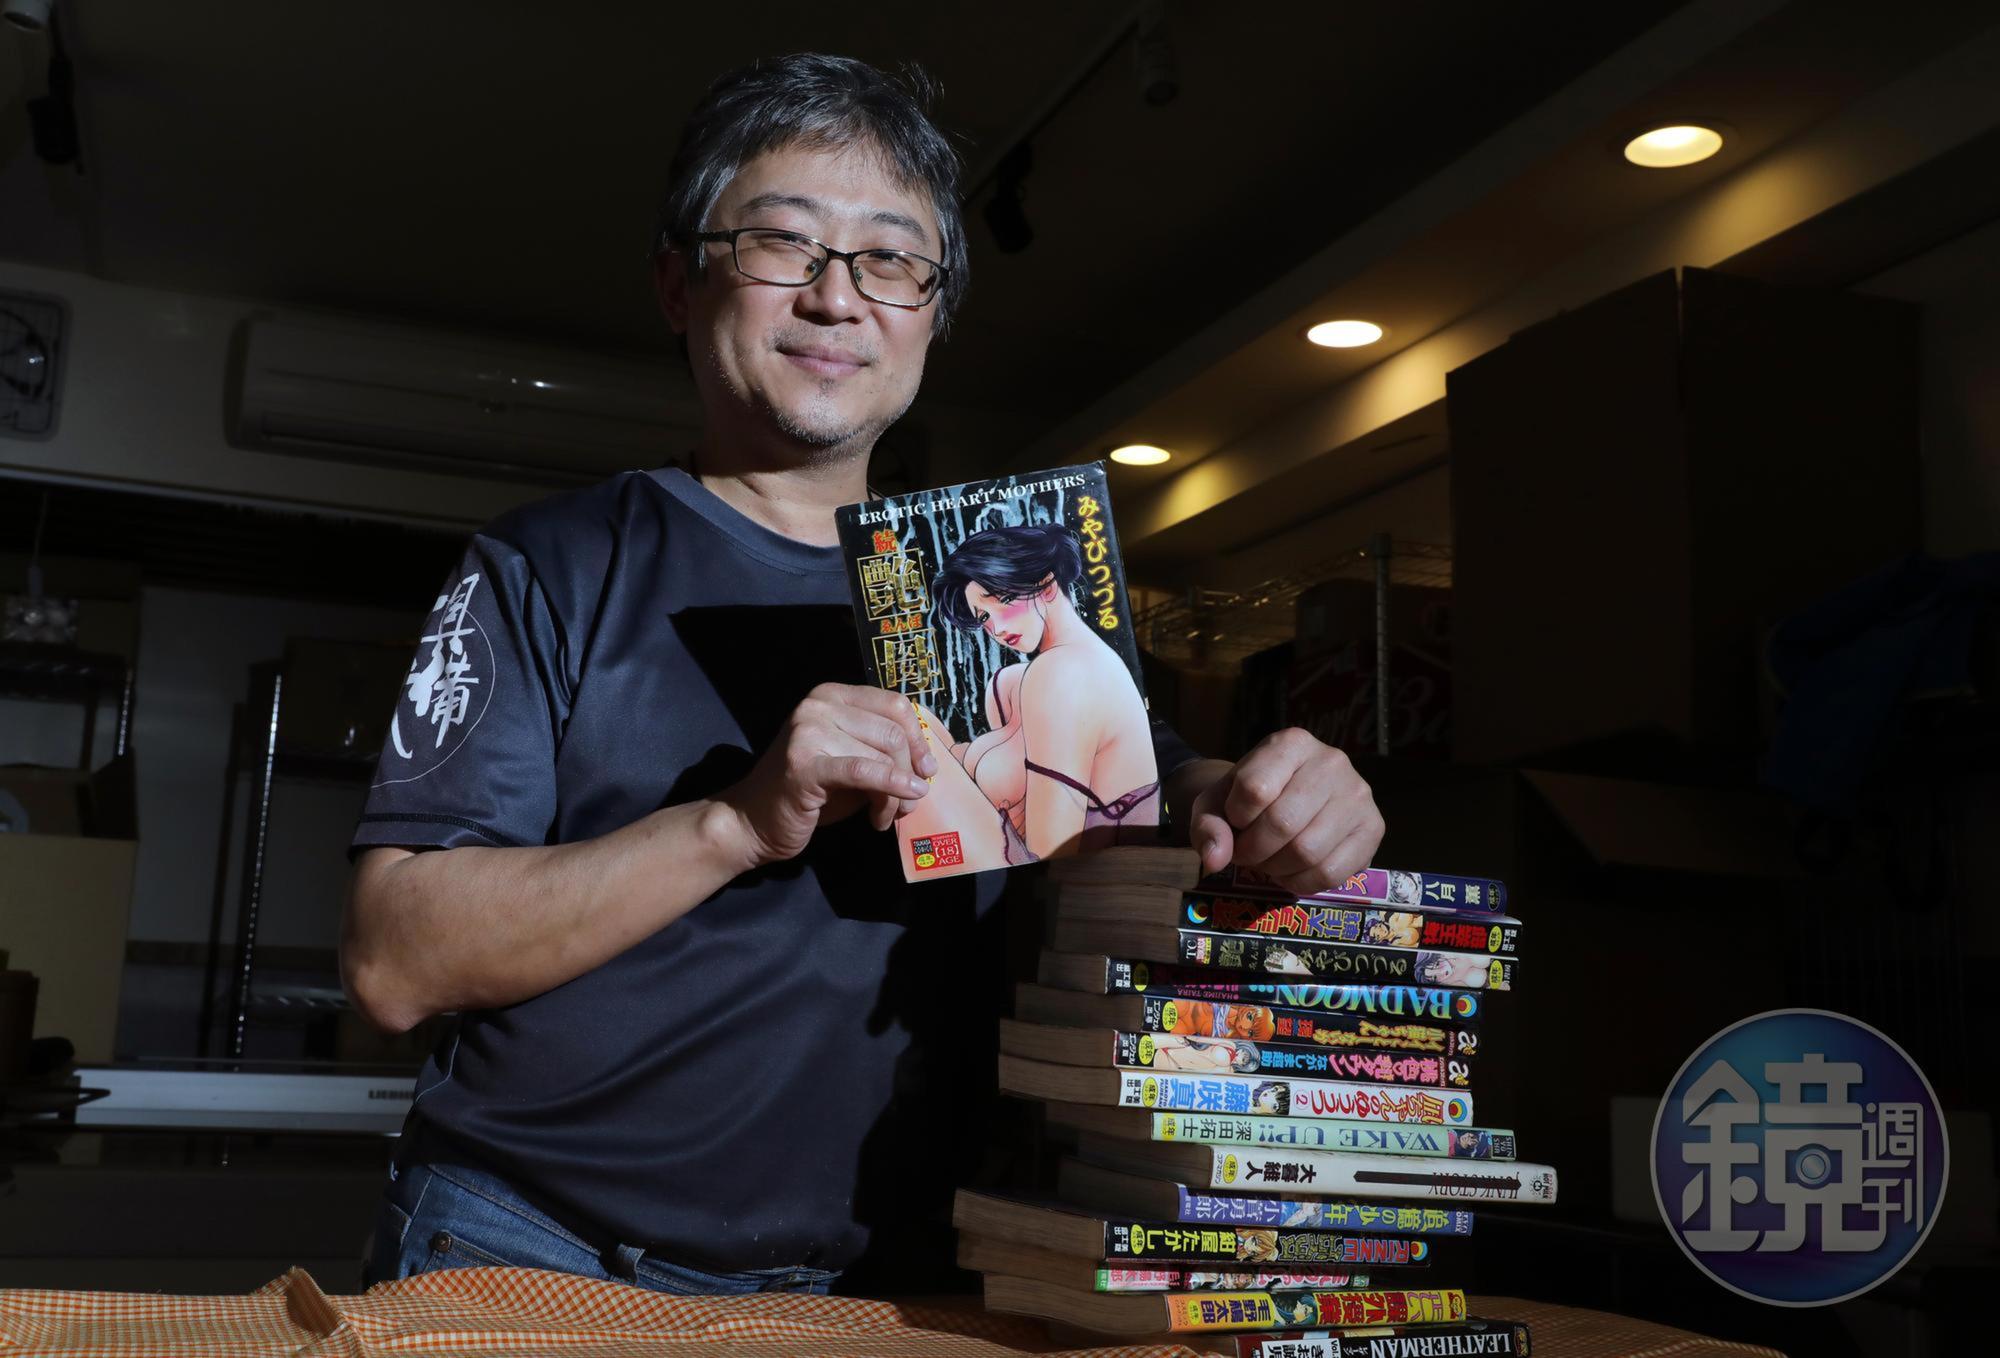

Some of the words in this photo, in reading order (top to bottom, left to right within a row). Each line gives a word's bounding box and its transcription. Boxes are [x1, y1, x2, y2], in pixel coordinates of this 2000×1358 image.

[858, 503, 927, 526] EROTIC
[930, 490, 992, 513] HEART
[998, 473, 1087, 500] MOTHERS
[1077, 495, 1120, 631] みやびつづる
[932, 837, 958, 848] OVER
[938, 855, 961, 866] AGE
[1425, 880, 1456, 904] 八月
[1186, 939, 1198, 960] TC
[1297, 947, 1408, 977] みやびつづる
[1168, 1078, 1250, 1113] 藤咲真
[1167, 1117, 1176, 1136] 成年
[1182, 1117, 1252, 1141] 深田拓士
[1259, 1123, 1325, 1145] UP!!
[1340, 1128, 1441, 1151] WAKE
[1245, 1160, 1317, 1184] 大暮維人
[1343, 1238, 1410, 1264] RINNE
[1369, 1333, 1512, 1358] LEATHERMAN
